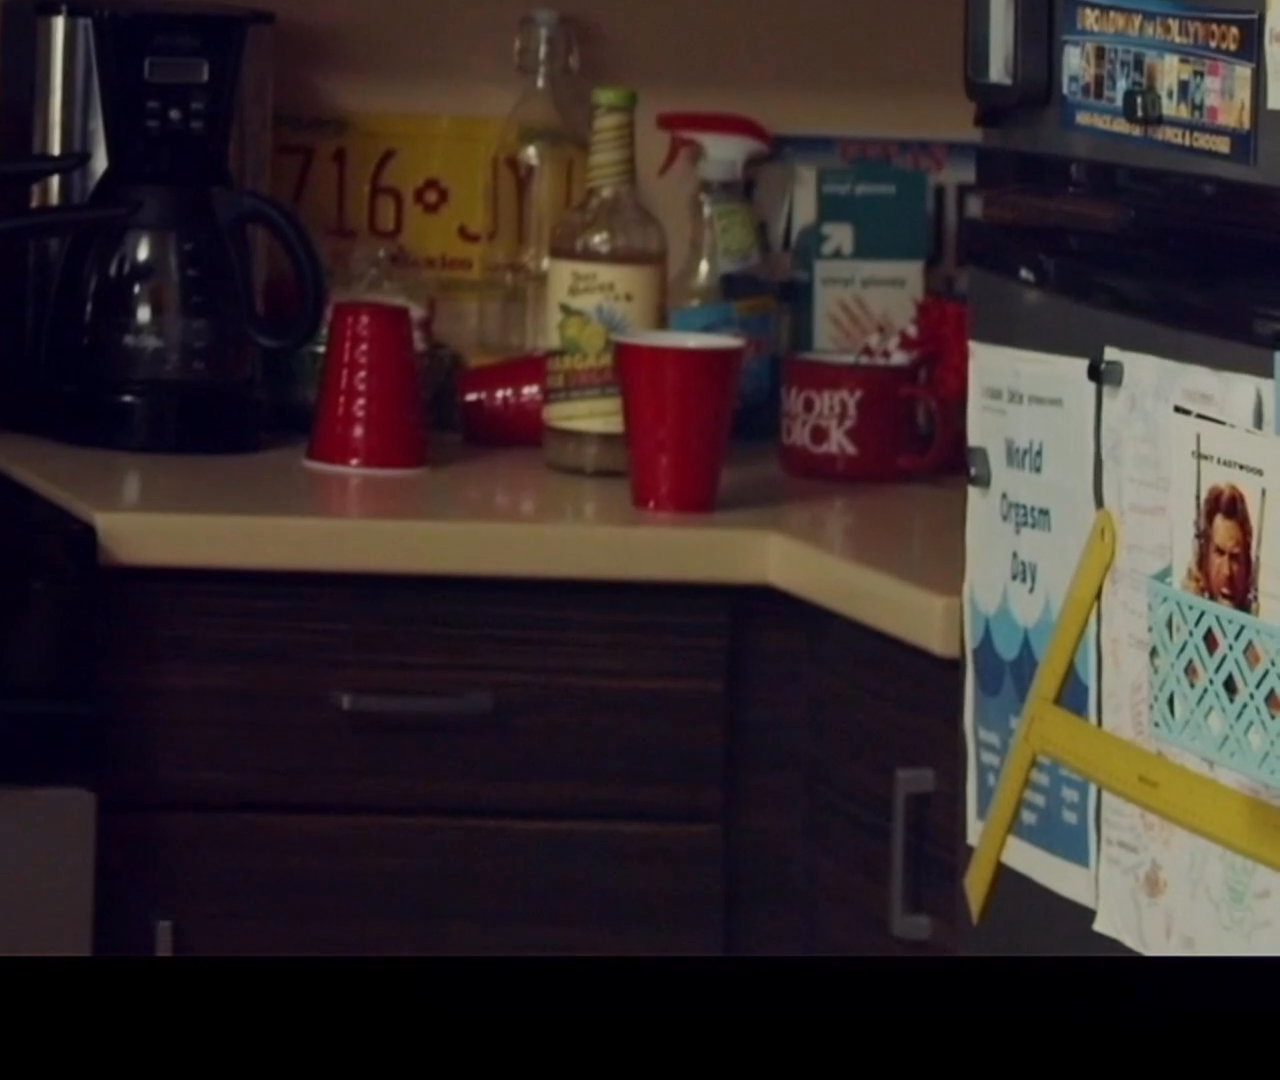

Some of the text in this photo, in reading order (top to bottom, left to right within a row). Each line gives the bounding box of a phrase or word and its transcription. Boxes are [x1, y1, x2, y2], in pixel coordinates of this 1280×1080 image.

[1156, 17, 1241, 52] HOLLYWOOD
[277, 144, 574, 242] 716 JY
[780, 385, 864, 433] MOBY
[781, 418, 859, 457] DICK
[1005, 437, 1044, 474] World
[1217, 457, 1265, 478] EASTWOOD
[1000, 492, 1052, 535] Orgasm
[1010, 551, 1038, 595] Day
